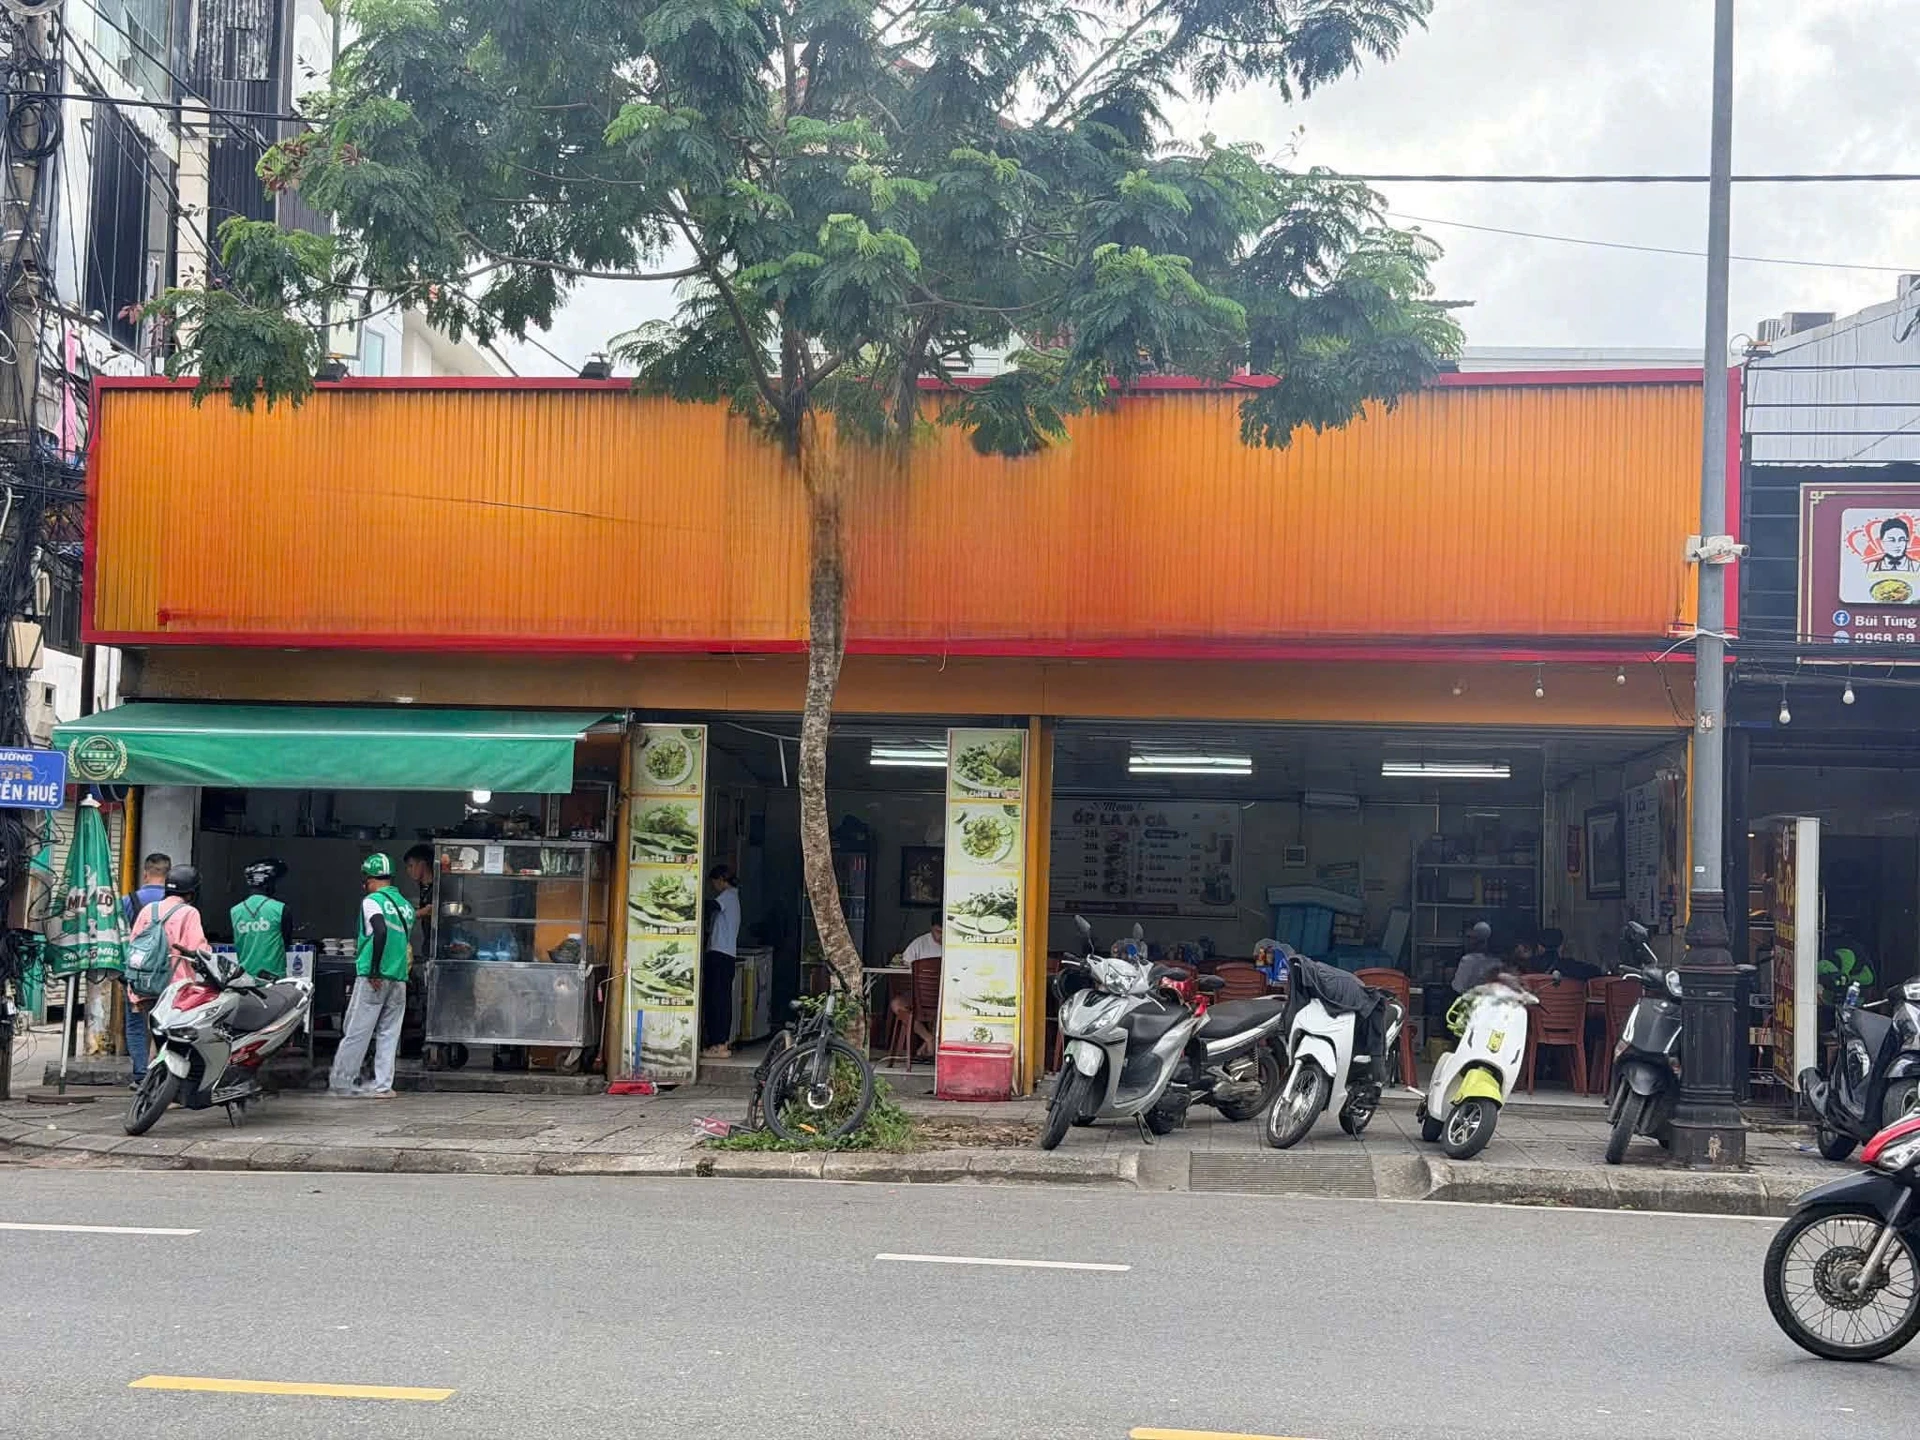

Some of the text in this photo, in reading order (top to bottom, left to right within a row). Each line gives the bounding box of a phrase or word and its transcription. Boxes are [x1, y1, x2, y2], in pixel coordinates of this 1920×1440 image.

[0, 751, 33, 762] ƯỜNG
[0, 777, 59, 805] ỄN HUỆ
[237, 916, 270, 933] Grab
